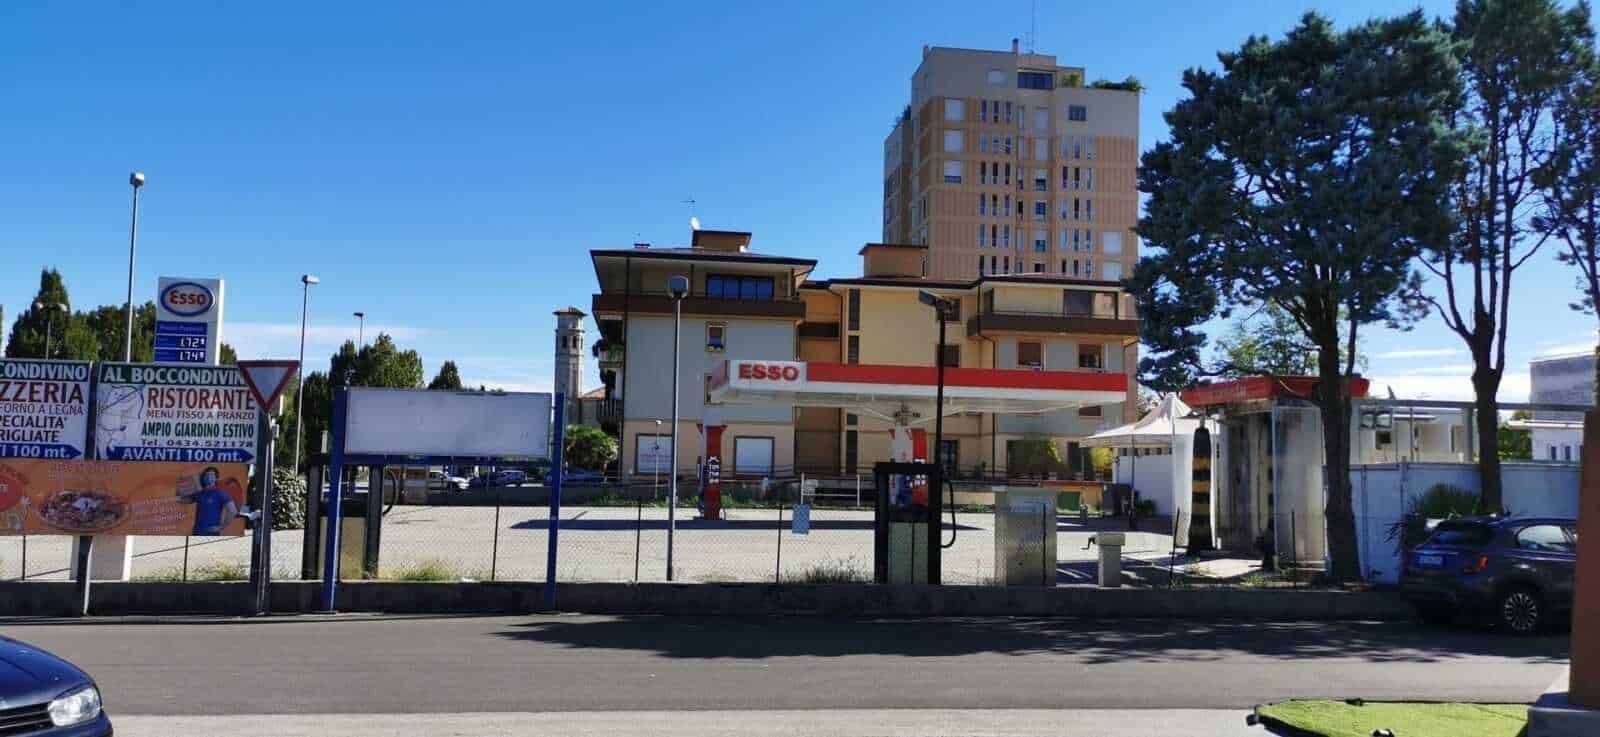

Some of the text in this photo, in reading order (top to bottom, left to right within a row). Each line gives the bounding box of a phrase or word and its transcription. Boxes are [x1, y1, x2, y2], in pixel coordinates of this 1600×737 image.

[104, 367, 245, 385] AL BOCCONDIVIN
[738, 363, 800, 381] ESSO
[147, 387, 256, 410] RISTORANTE
[38, 404, 46, 414] A
[48, 404, 84, 416] LEGNA
[176, 410, 204, 419] FISSO
[217, 411, 255, 420] PRANZO
[141, 421, 254, 438] AMPIO GIARDINO ESTIVO
[12, 445, 41, 457] 100
[44, 446, 72, 459] mt.
[123, 447, 243, 463] AVANTI 100 mt.
